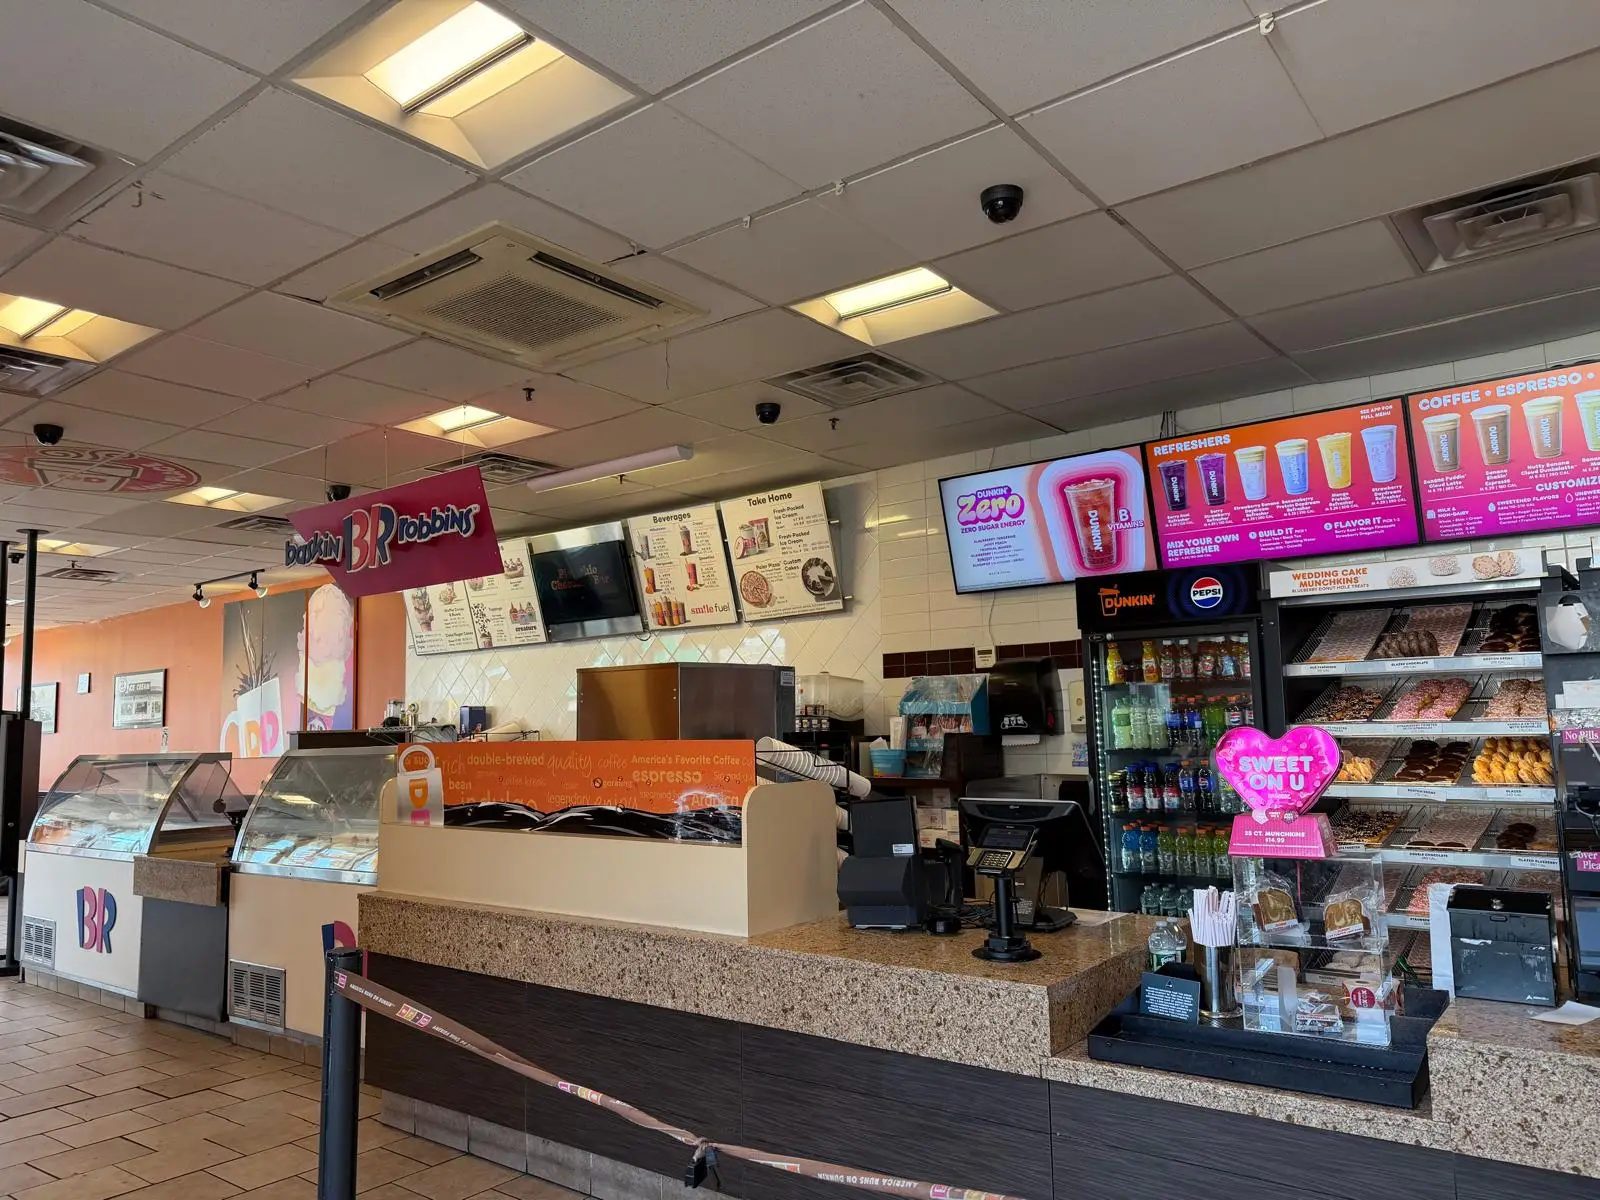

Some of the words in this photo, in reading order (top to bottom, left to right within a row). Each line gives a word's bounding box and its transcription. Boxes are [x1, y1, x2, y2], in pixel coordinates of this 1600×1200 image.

[1418, 389, 1481, 411] COFFEE
[1495, 372, 1583, 398] ESPRESSO
[1153, 434, 1231, 457] REFRESHERS
[1535, 475, 1600, 492] CUSTOMIZ
[747, 498, 767, 507] Take
[767, 491, 793, 503] Home
[976, 487, 1009, 499] DUNKIN'
[781, 511, 798, 519] Cream
[957, 493, 1025, 526] Zero
[1117, 508, 1132, 523] B
[652, 512, 691, 524] Beverages
[1334, 517, 1371, 529] FLAVOR
[978, 523, 1000, 532] SUGAR
[1000, 519, 1026, 529] ENERGY
[1087, 509, 1104, 553] DUNKIN'
[1107, 519, 1145, 532] VITAMINS
[1258, 528, 1284, 538] BUILD
[1285, 527, 1294, 535] IT
[285, 530, 344, 569] baskin
[341, 503, 397, 574] BR
[397, 504, 476, 545] robbins
[1166, 539, 1184, 549] MIX
[1185, 537, 1213, 547] YOUR
[1213, 533, 1240, 544] OWN
[1167, 544, 1220, 557] REFRESHER
[1291, 571, 1340, 583] WEDDING
[1341, 566, 1369, 578] CAKE
[1299, 576, 1360, 589] MUNCHKINS
[1192, 588, 1221, 597] PEPSI
[714, 602, 731, 613] fuel
[1104, 594, 1156, 609] DUNKIN'
[1565, 731, 1578, 740] No
[466, 753, 545, 766] double-brewed
[547, 749, 592, 778] quality
[597, 754, 628, 769] coffee
[631, 754, 673, 765] America's
[675, 755, 711, 765] Favorite
[712, 755, 740, 766] Coffee
[1238, 756, 1314, 773] SWEET
[448, 779, 472, 790] bean
[631, 770, 702, 785] espresso
[1249, 774, 1284, 791] ON
[1289, 774, 1304, 791] U
[547, 791, 591, 807] legendary
[76, 885, 118, 954] BR
[859, 1176, 880, 1186] RUNS
[882, 1178, 919, 1189] AMERICA
